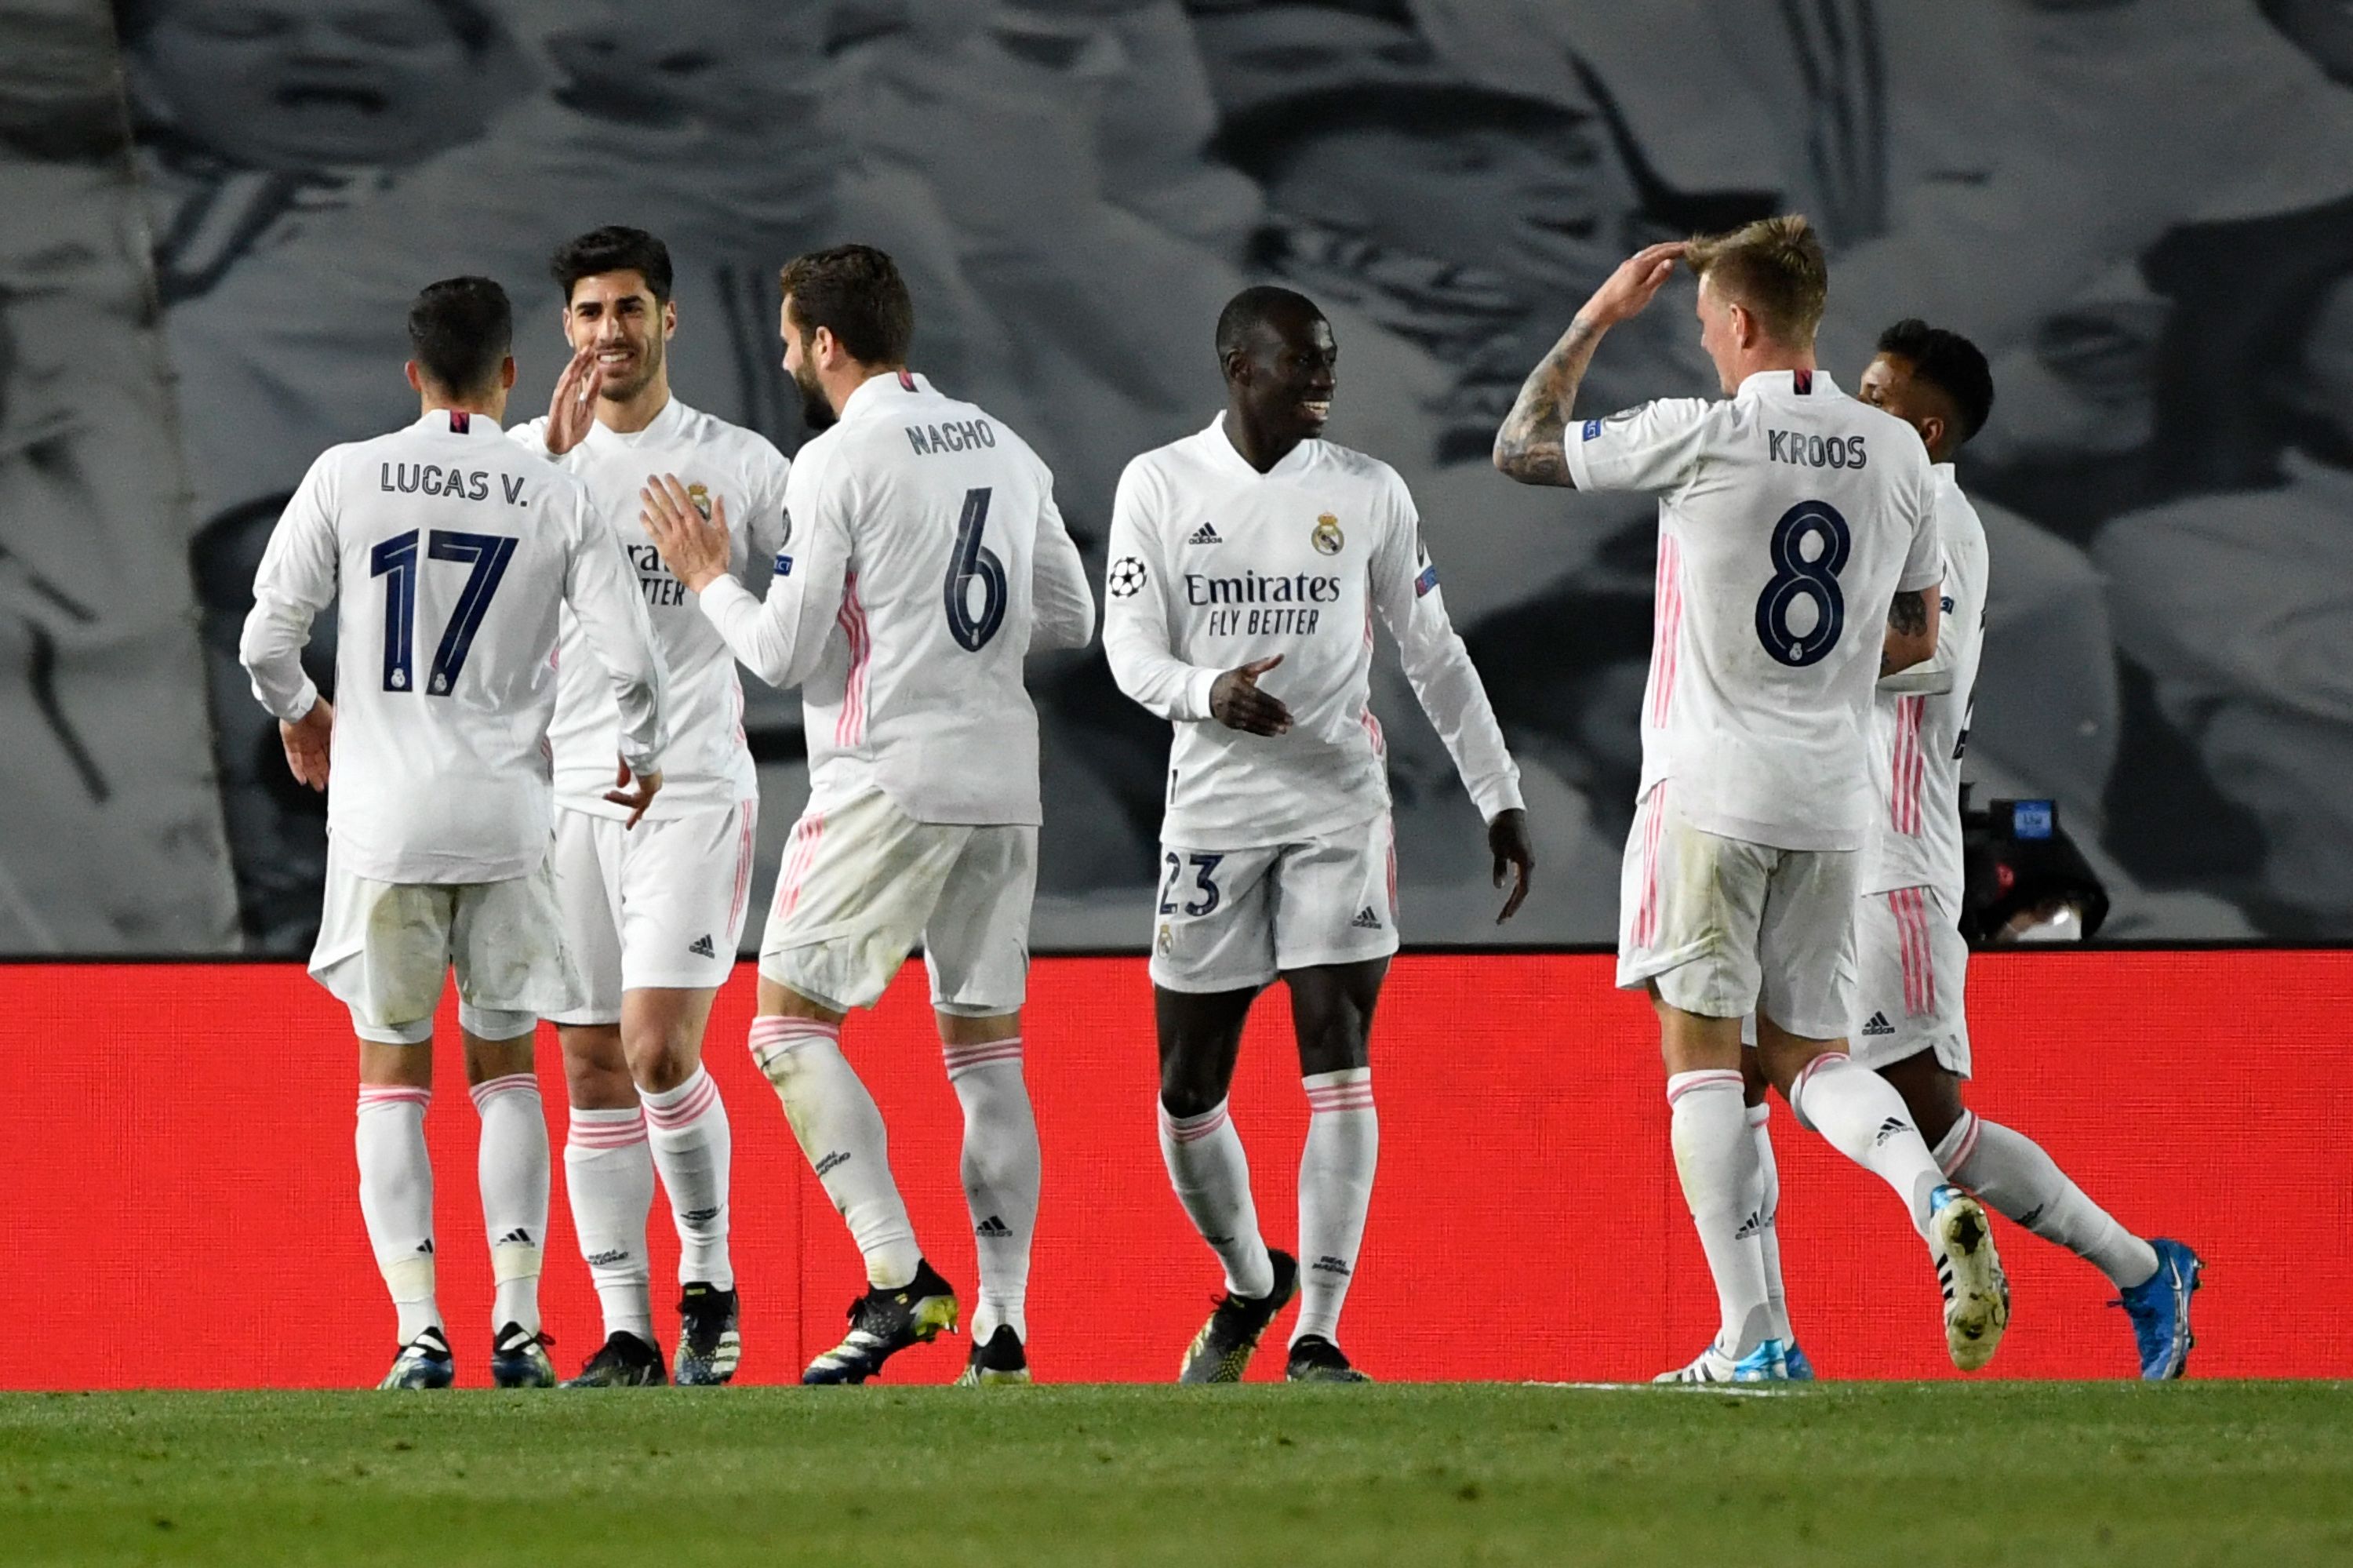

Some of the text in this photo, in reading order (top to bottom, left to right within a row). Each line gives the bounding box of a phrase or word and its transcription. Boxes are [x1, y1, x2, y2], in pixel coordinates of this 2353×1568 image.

[906, 419, 996, 456] NACHO
[1768, 429, 1867, 470] KROOS
[381, 462, 528, 508] LUCAS V.
[1188, 536, 1223, 545] adidas
[944, 487, 1007, 653] 6
[1184, 569, 1340, 606] Emirates
[1755, 500, 1851, 668] 8
[371, 527, 519, 697] 17
[1209, 609, 1319, 637] FLY BETTER
[1158, 852, 1225, 917] 23
